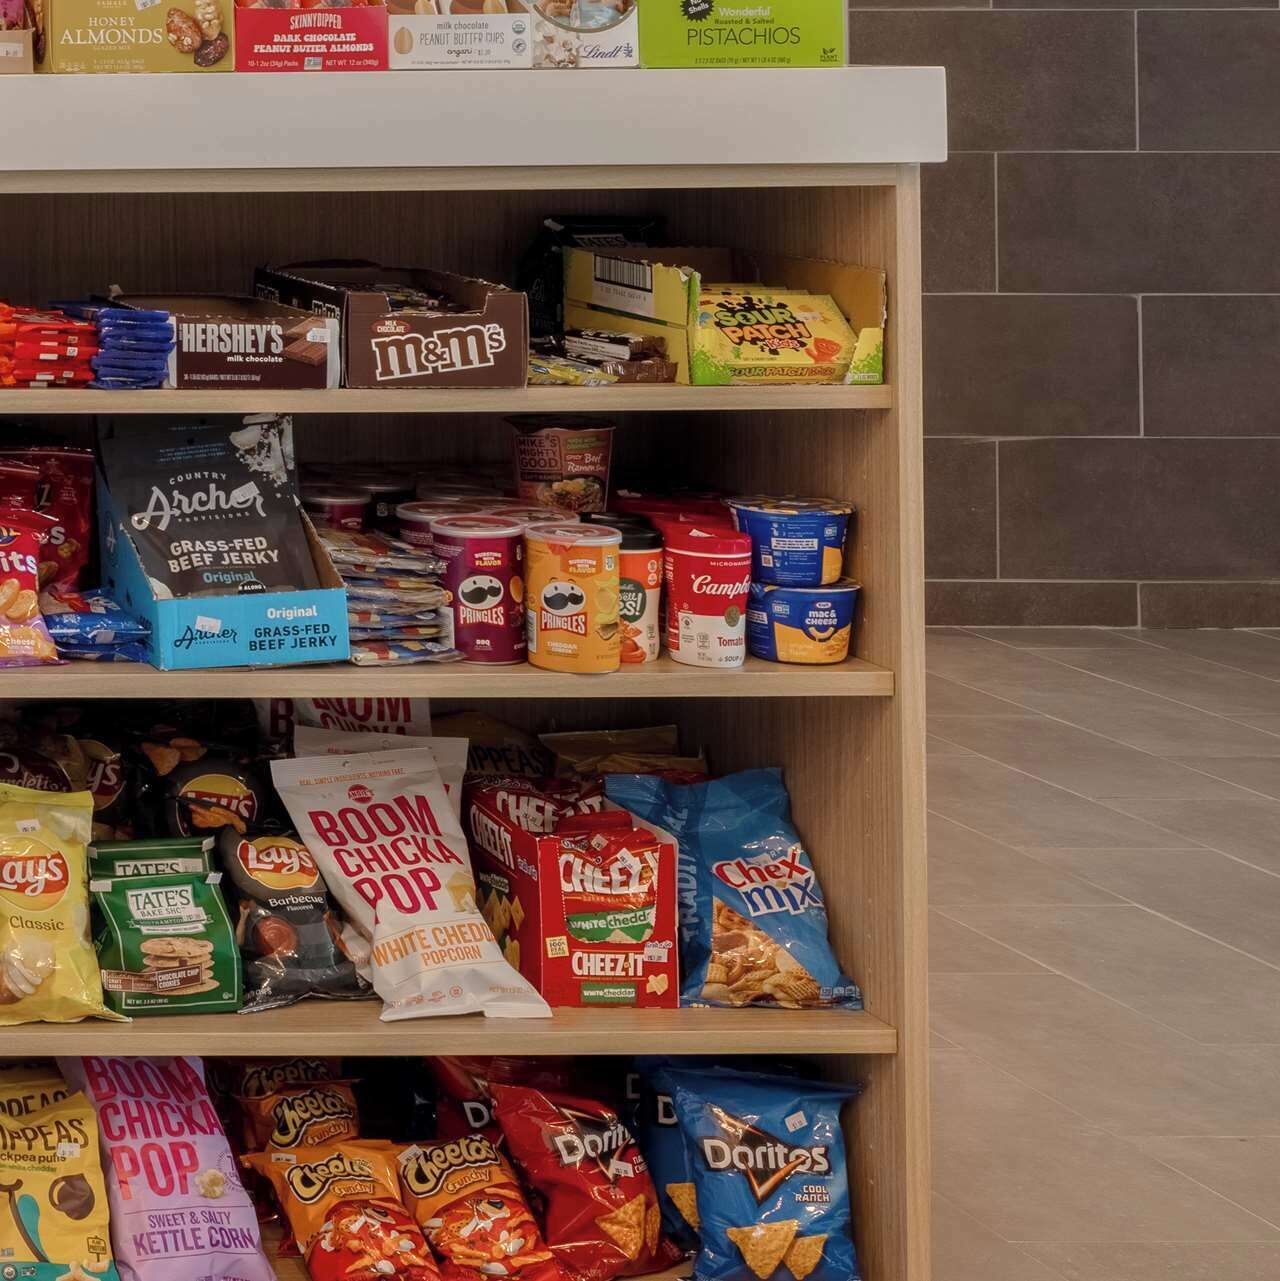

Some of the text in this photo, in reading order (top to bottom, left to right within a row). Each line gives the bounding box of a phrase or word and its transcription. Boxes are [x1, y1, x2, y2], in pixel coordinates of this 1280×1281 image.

[88, 16, 135, 27] HONEY
[290, 14, 342, 30] SKINNYDIPPED
[718, 7, 771, 17] Wonderful
[437, 21, 489, 30] milk chocolate
[60, 28, 163, 45] ALMONDS
[273, 33, 356, 42] DARK CHOCOLATE
[420, 33, 505, 45] PEANUT BUTTER CUPS
[687, 27, 801, 48] PISTACHIOS
[254, 43, 374, 53] PEANUT BUTTER ALMONDS
[582, 44, 623, 60] Lindt
[714, 308, 794, 327] SOUR
[182, 322, 284, 353] HERSHEY'S
[722, 322, 811, 344] PATCH
[227, 355, 284, 363] milk chocolate
[372, 323, 507, 381] m&m's
[518, 434, 557, 448] MIKE'S
[519, 449, 557, 457] MIGHTY
[520, 458, 558, 468] GOOD
[170, 471, 227, 486] COUNTRY
[131, 481, 266, 531] Archer
[170, 536, 268, 556] GRASS-FED
[167, 549, 280, 574] BEEF JERKY
[203, 571, 255, 584] Original
[266, 606, 318, 620] Original
[460, 606, 504, 626] PRINGLES
[541, 612, 586, 634] PRINGLES
[253, 623, 330, 639] GRASS-FED
[248, 633, 338, 652] BEEF JERKY
[308, 794, 443, 847] BOOM
[247, 840, 319, 873] Lay's
[333, 834, 464, 877] CHICKA
[713, 848, 809, 888] Chex
[130, 888, 191, 910] TATE'S
[268, 893, 323, 908] Barbecue
[352, 867, 442, 924] POP
[743, 876, 822, 915] mix
[9, 916, 65, 932] Classic
[423, 945, 482, 966] POPCORN
[572, 952, 644, 976] CHEEZ-IT
[87, 1056, 208, 1102] BOOM
[101, 1099, 223, 1141] CHICKA
[304, 1120, 350, 1147] Crunchy
[703, 1137, 830, 1172] Doritos
[111, 1141, 199, 1200] POP
[402, 1136, 500, 1197] Cheetos
[444, 1167, 490, 1194] Crunchy
[803, 1185, 829, 1194] COOL
[795, 1193, 831, 1203] RANCH
[148, 1210, 232, 1228] SWEET & SALTY
[133, 1225, 257, 1257] KETTLE CORN
